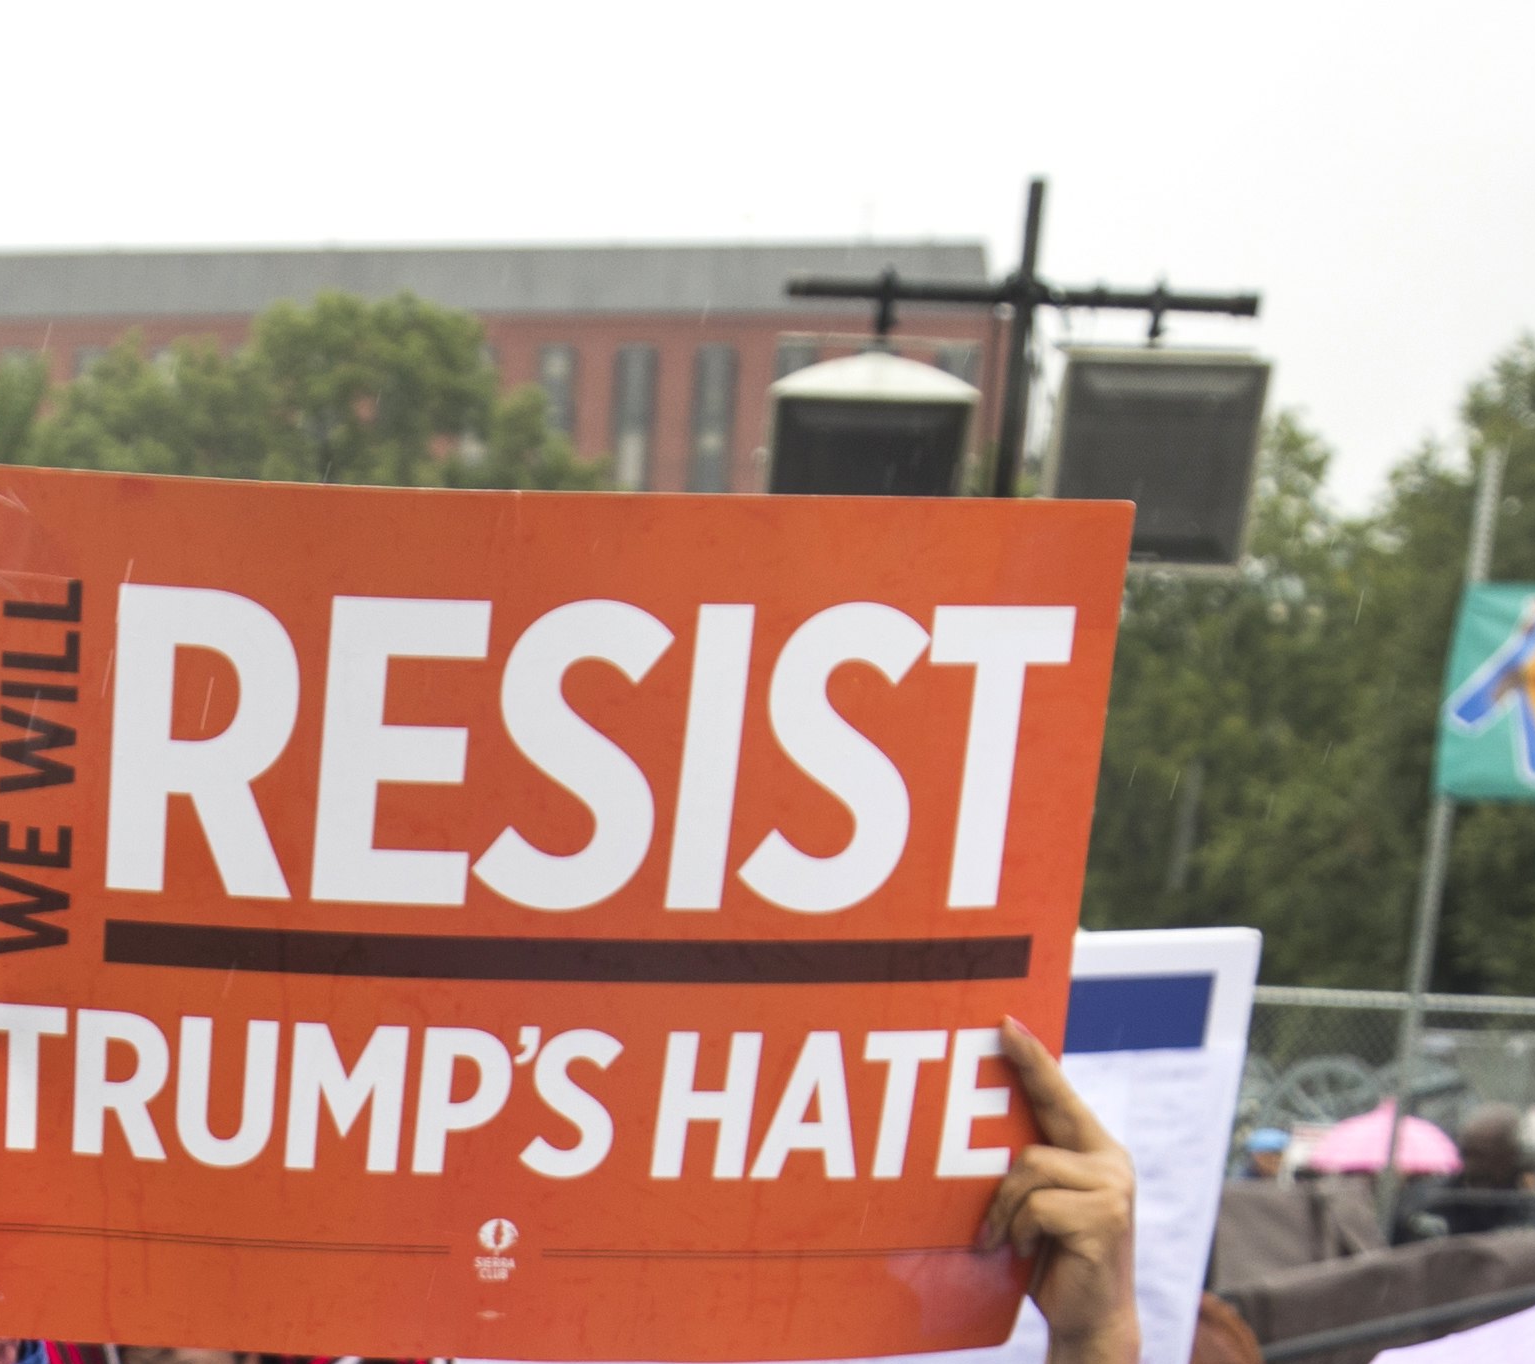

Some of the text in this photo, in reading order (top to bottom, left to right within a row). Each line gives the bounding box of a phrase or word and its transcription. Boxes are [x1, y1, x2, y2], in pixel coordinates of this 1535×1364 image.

[105, 583, 1076, 913] RESIST
[651, 1026, 1011, 1181] HATE
[479, 1268, 508, 1280] CLUB
